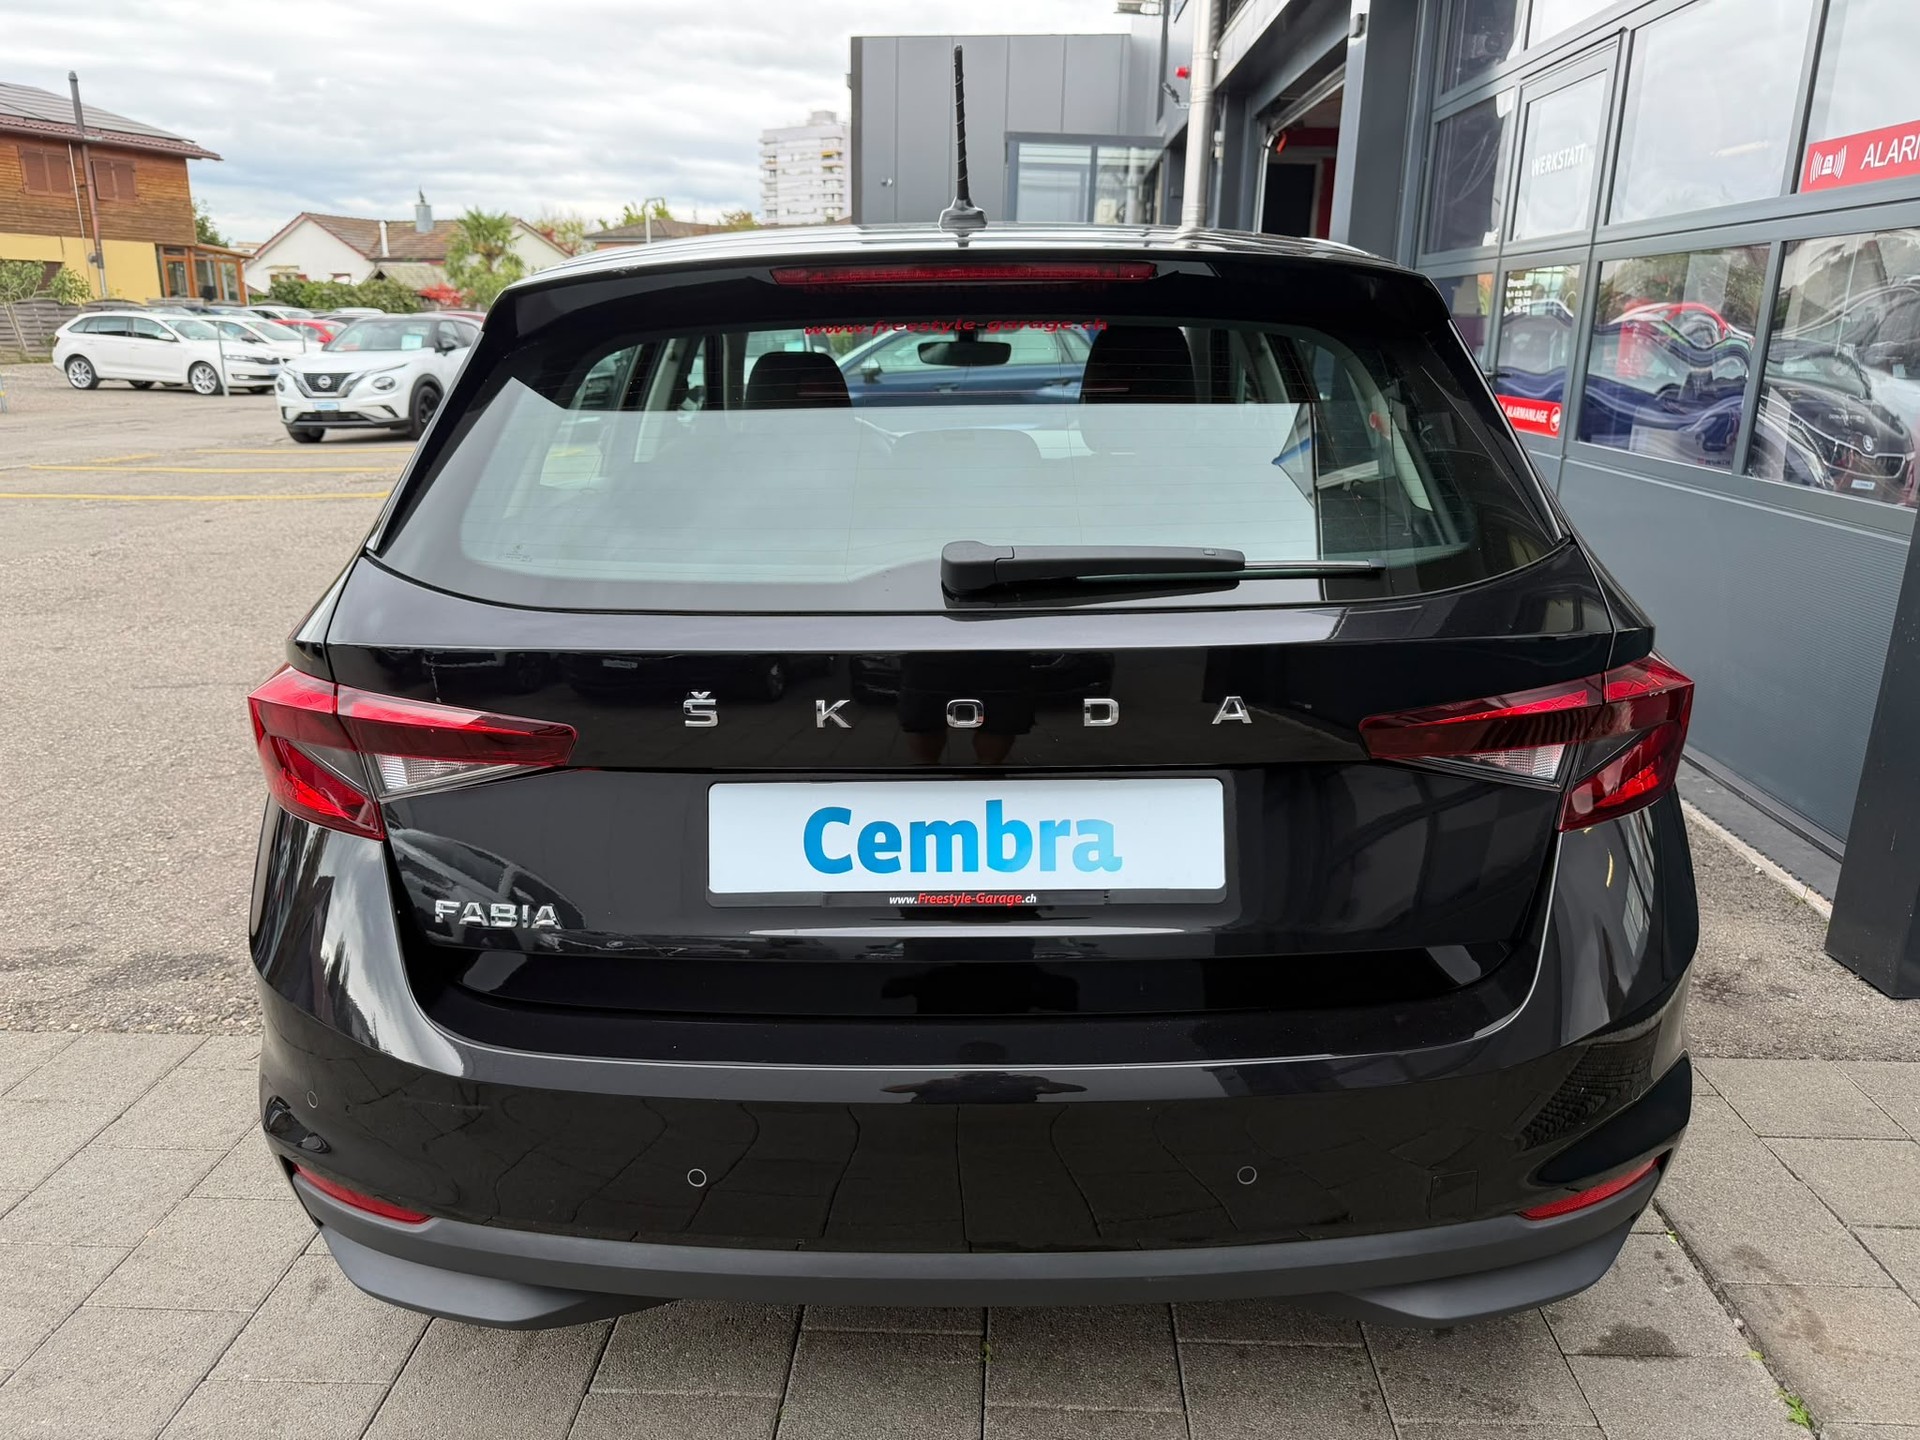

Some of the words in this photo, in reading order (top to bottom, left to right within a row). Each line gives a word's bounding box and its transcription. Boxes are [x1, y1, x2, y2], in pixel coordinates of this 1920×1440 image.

[1531, 143, 1586, 176] WERKSTATT
[684, 691, 1253, 728] ŠKODA
[803, 799, 1123, 874] Cembra
[434, 900, 562, 929] FABIA
[889, 893, 1037, 907] www.Freestyle-Garage.ch
